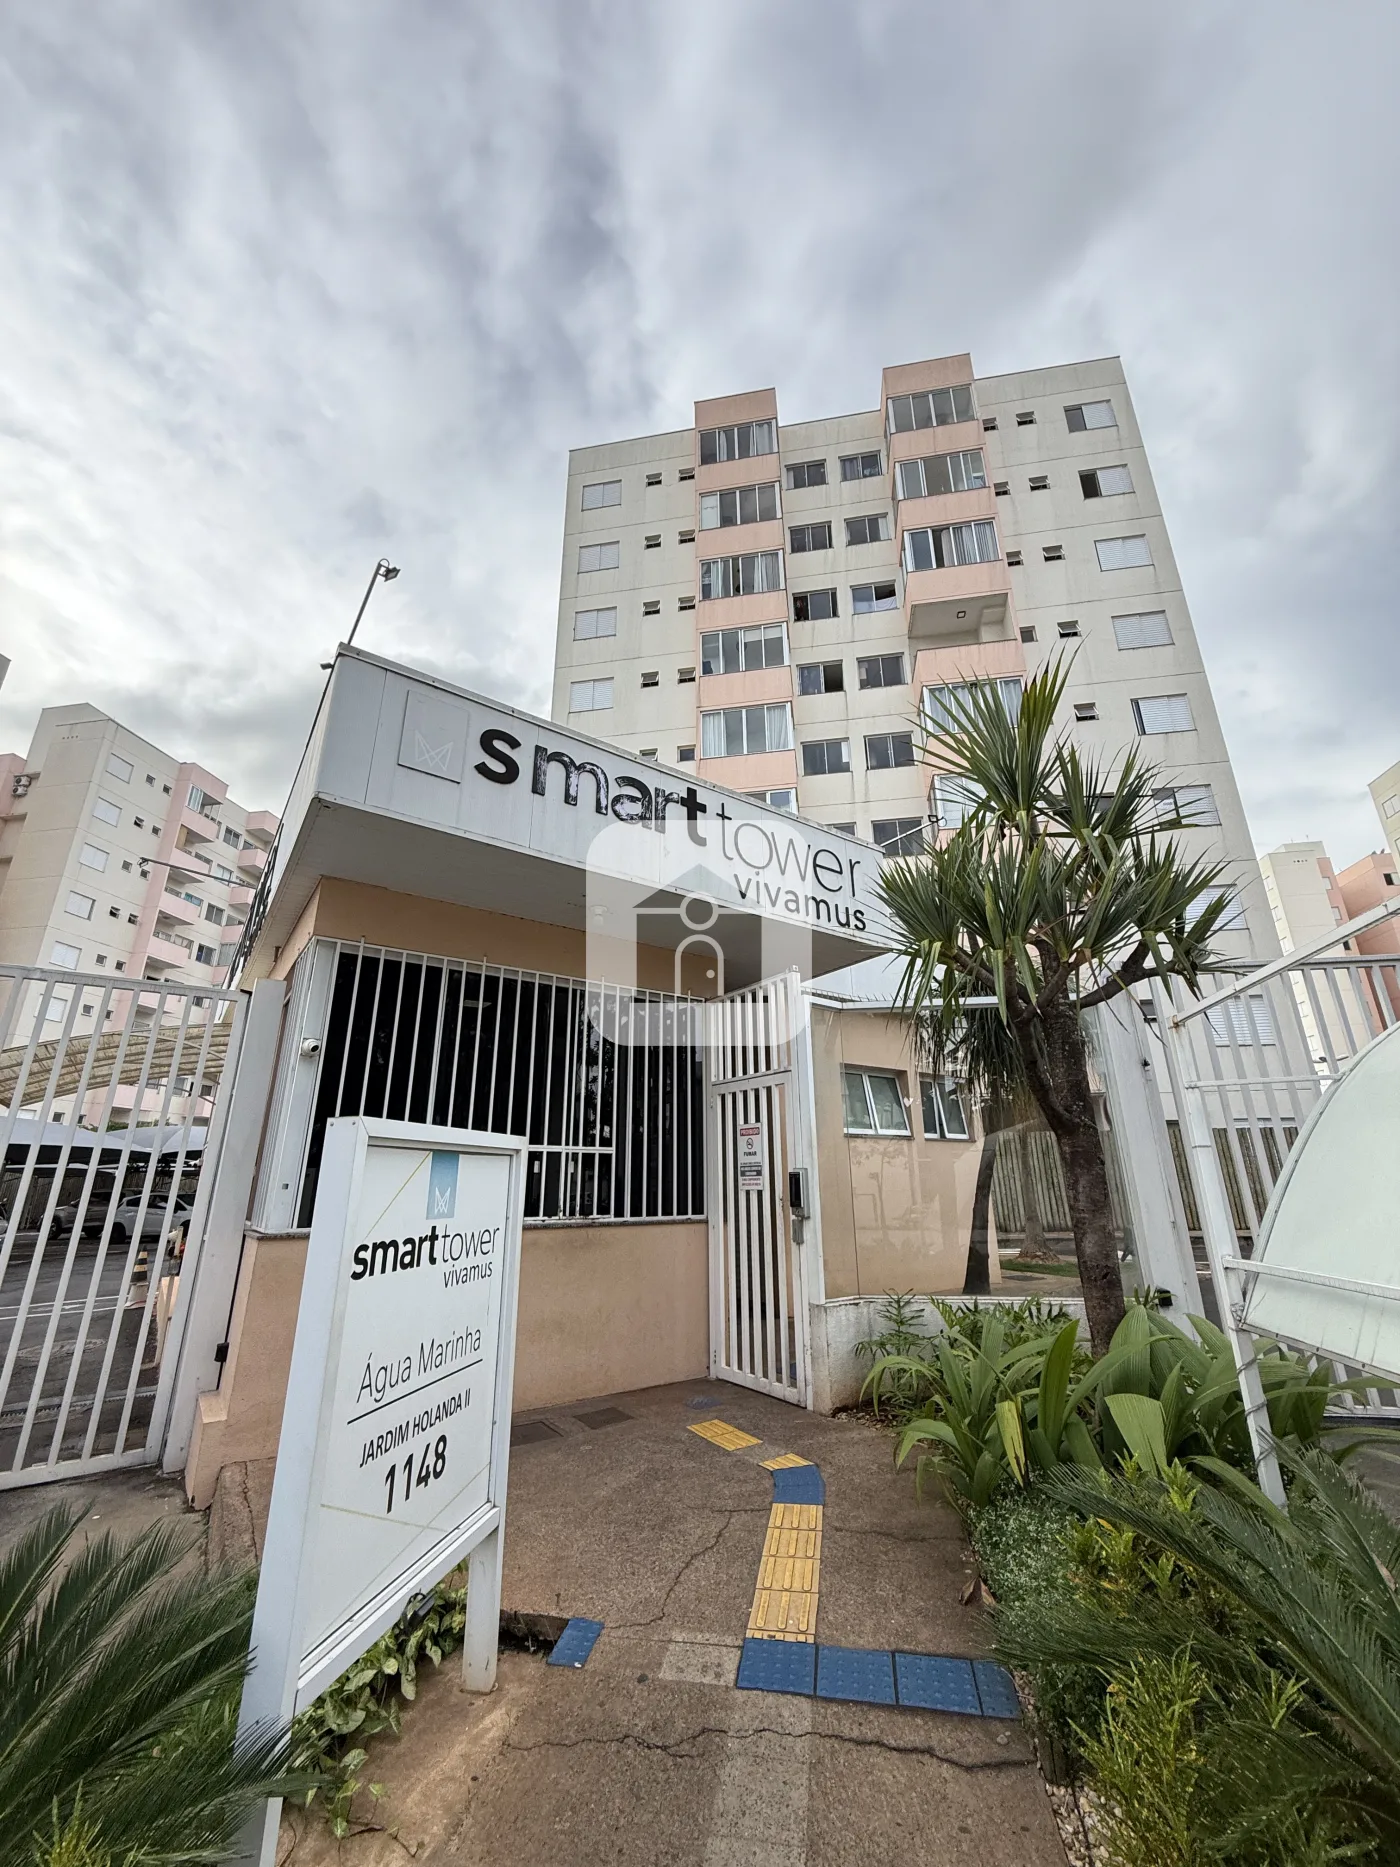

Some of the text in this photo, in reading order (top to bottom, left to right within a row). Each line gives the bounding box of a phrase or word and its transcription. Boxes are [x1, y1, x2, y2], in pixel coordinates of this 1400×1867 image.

[474, 728, 707, 847] smart
[733, 872, 866, 932] vivamus
[443, 1261, 493, 1289] vivamus
[356, 1326, 481, 1403] Água Marinha
[359, 1388, 471, 1468] JARDIM HOLANDA II
[384, 1434, 448, 1515] 1148
